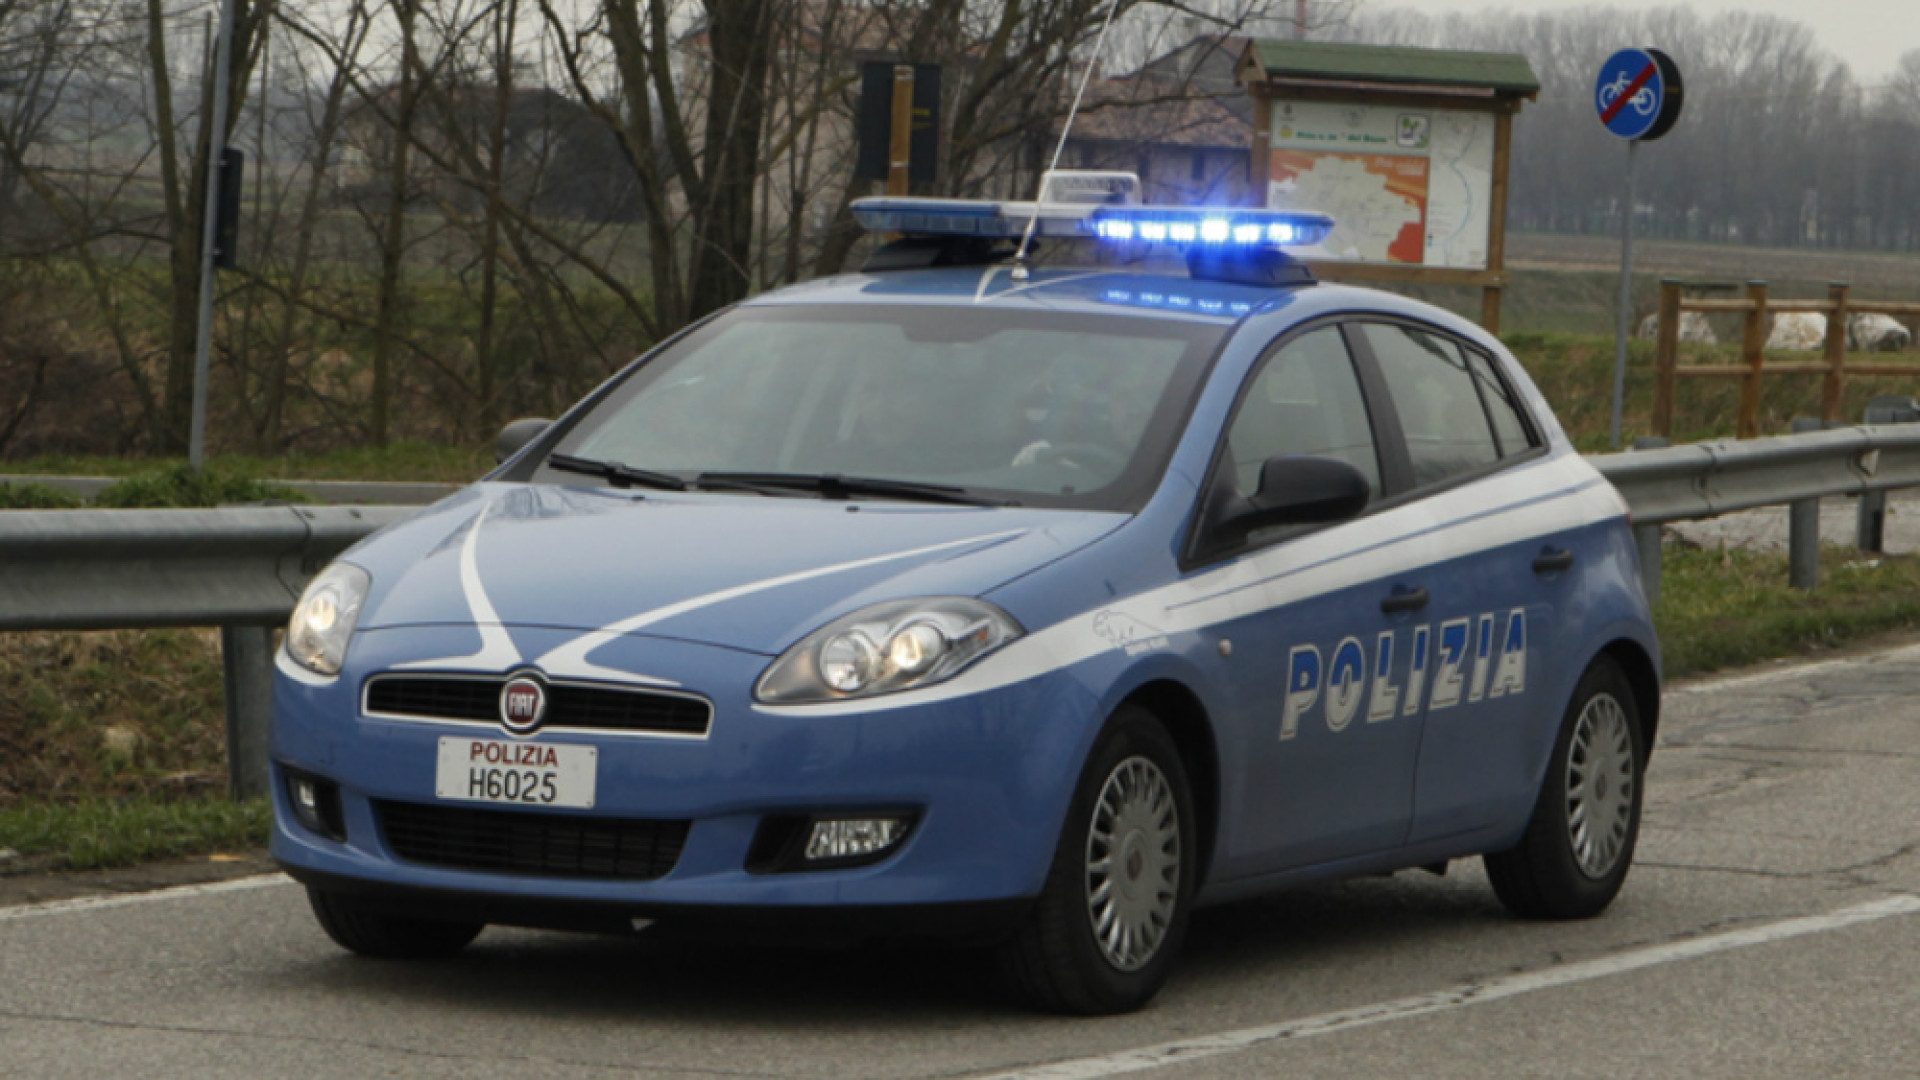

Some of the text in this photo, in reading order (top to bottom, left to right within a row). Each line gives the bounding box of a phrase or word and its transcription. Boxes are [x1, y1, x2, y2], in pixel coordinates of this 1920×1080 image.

[1279, 607, 1526, 740] POLIZIA
[470, 741, 558, 766] POLIZIA
[469, 768, 558, 803] H6025
